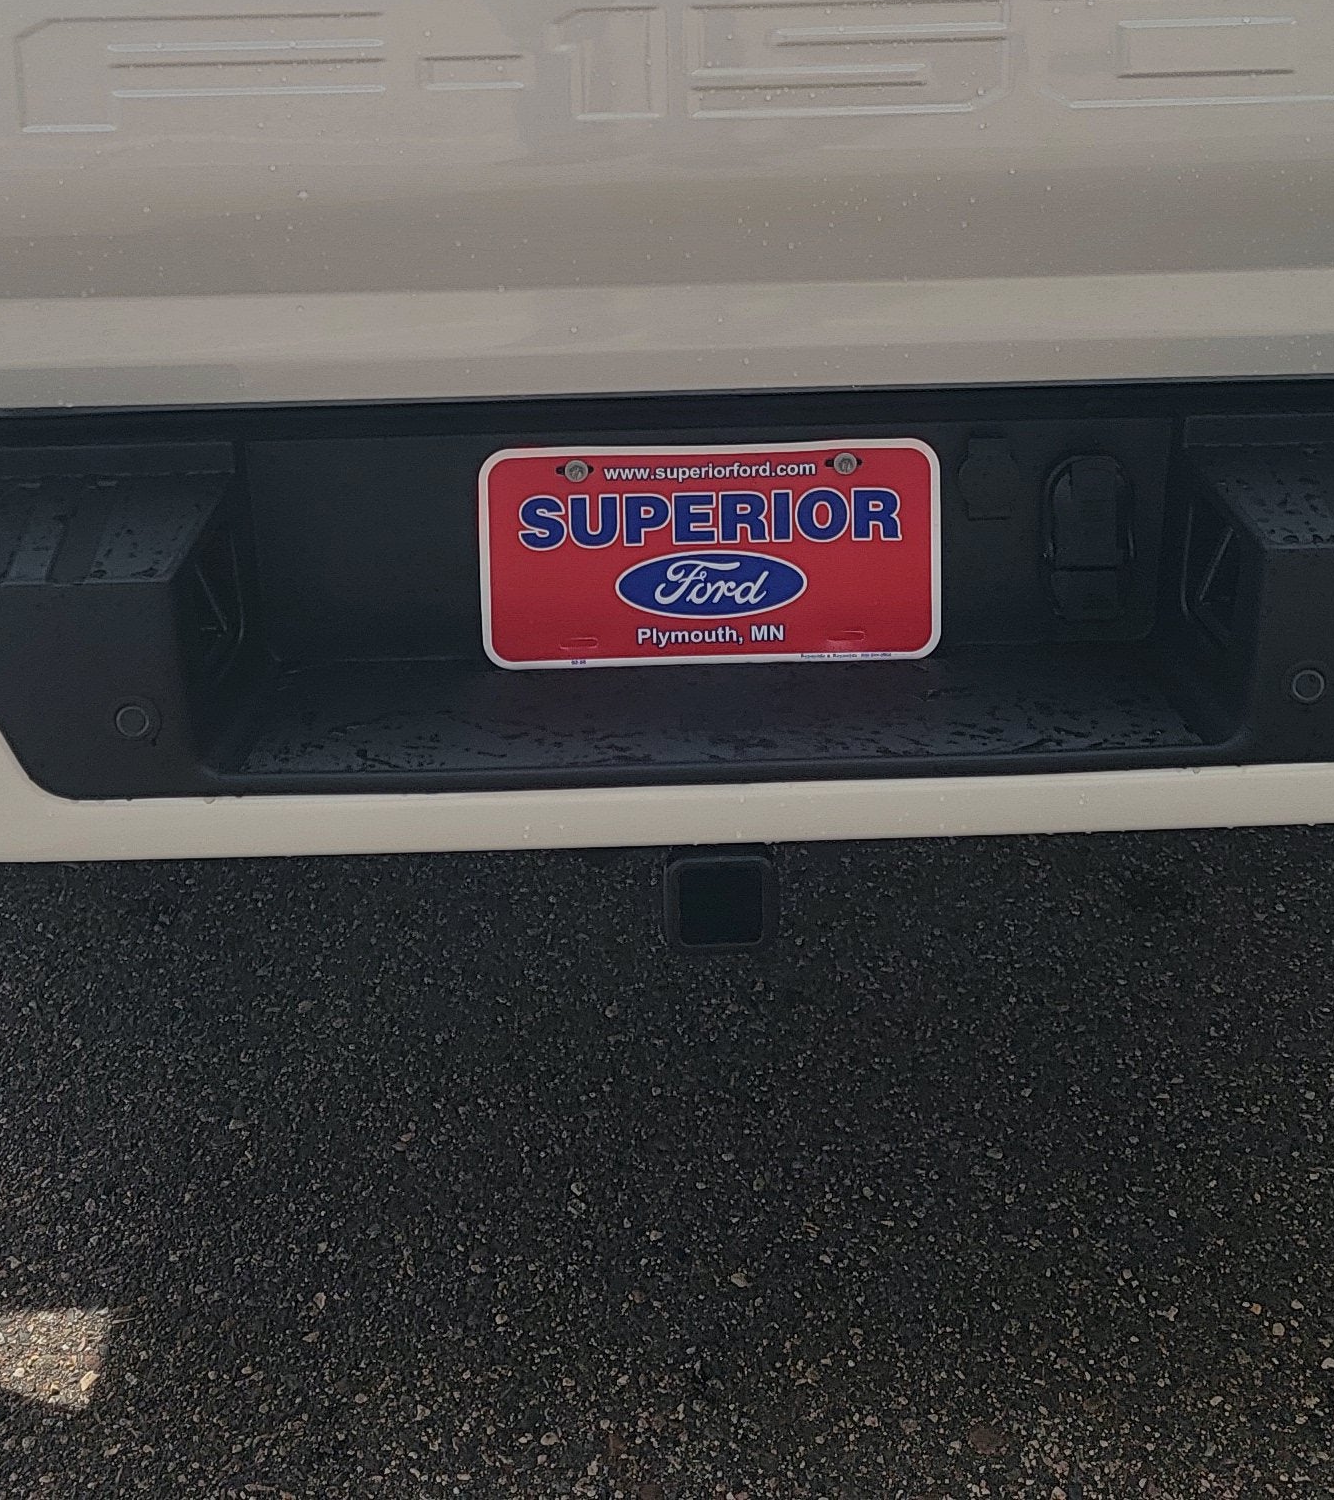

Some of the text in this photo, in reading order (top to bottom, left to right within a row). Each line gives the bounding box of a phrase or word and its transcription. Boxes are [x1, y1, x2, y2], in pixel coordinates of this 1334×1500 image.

[603, 462, 817, 483] www.superiorford.com
[518, 487, 902, 551] SUPERIOR
[654, 560, 769, 605] Ford
[637, 624, 784, 648] Plymouth, MN
